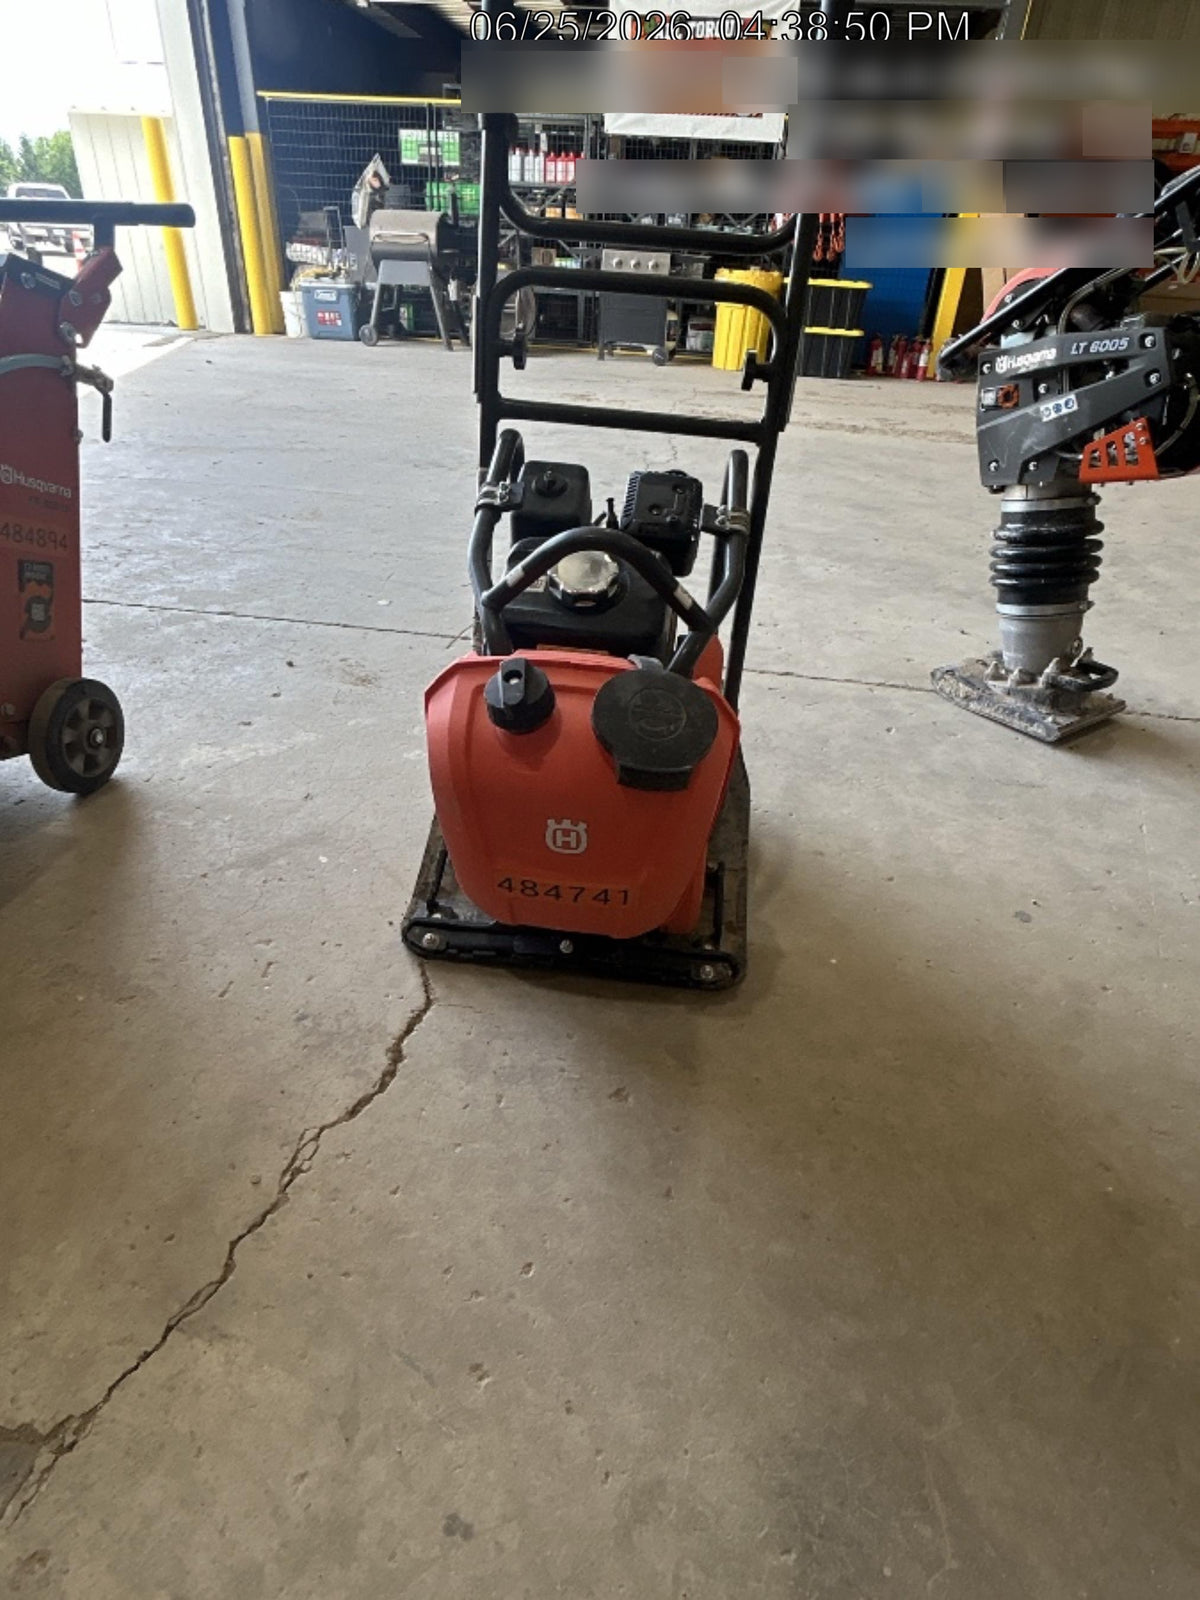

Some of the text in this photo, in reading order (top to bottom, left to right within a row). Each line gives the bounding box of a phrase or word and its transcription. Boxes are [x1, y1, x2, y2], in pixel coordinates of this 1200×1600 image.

[1070, 342, 1088, 354] LT
[13, 469, 72, 498] Husqvarna
[0, 522, 68, 550] 484894
[497, 877, 629, 905] 484741
